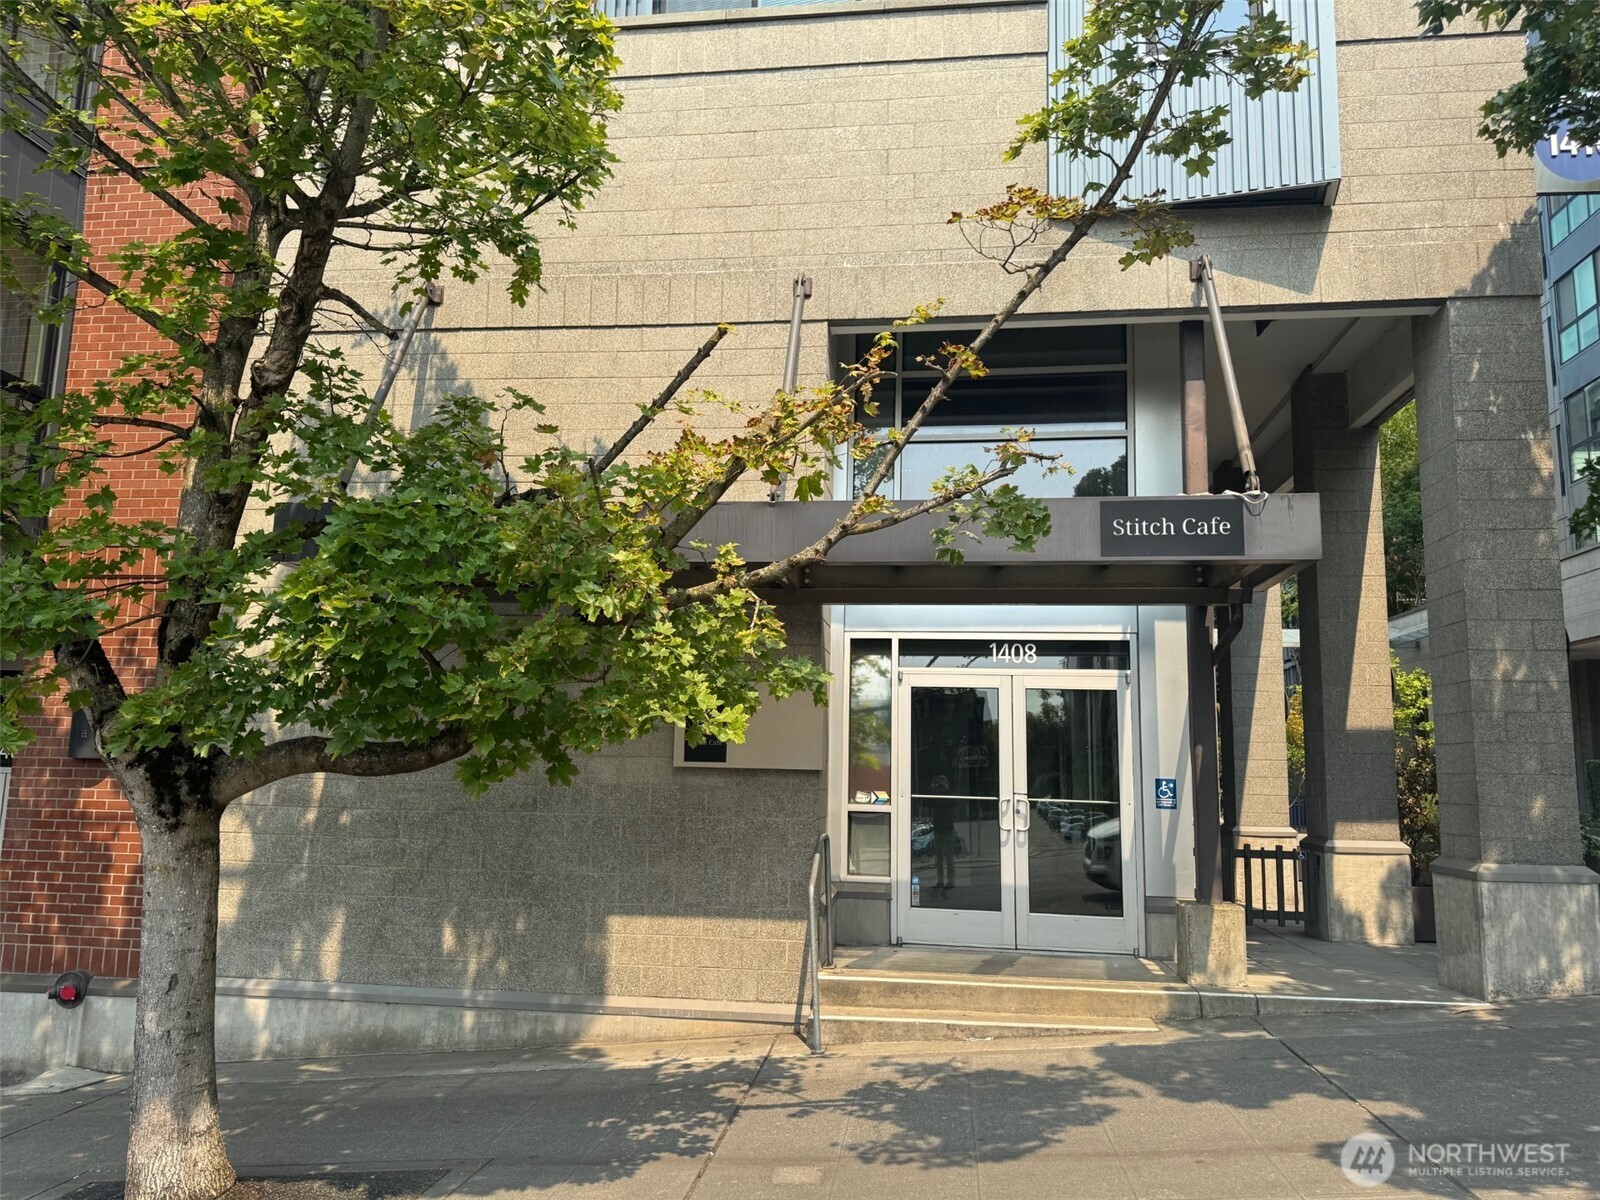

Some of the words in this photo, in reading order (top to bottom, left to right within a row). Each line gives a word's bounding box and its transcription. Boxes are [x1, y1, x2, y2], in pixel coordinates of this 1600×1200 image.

[1545, 132, 1600, 155] 14
[1112, 517, 1175, 536] Stitch
[1182, 517, 1231, 535] Cafe
[989, 642, 1037, 664] 1408
